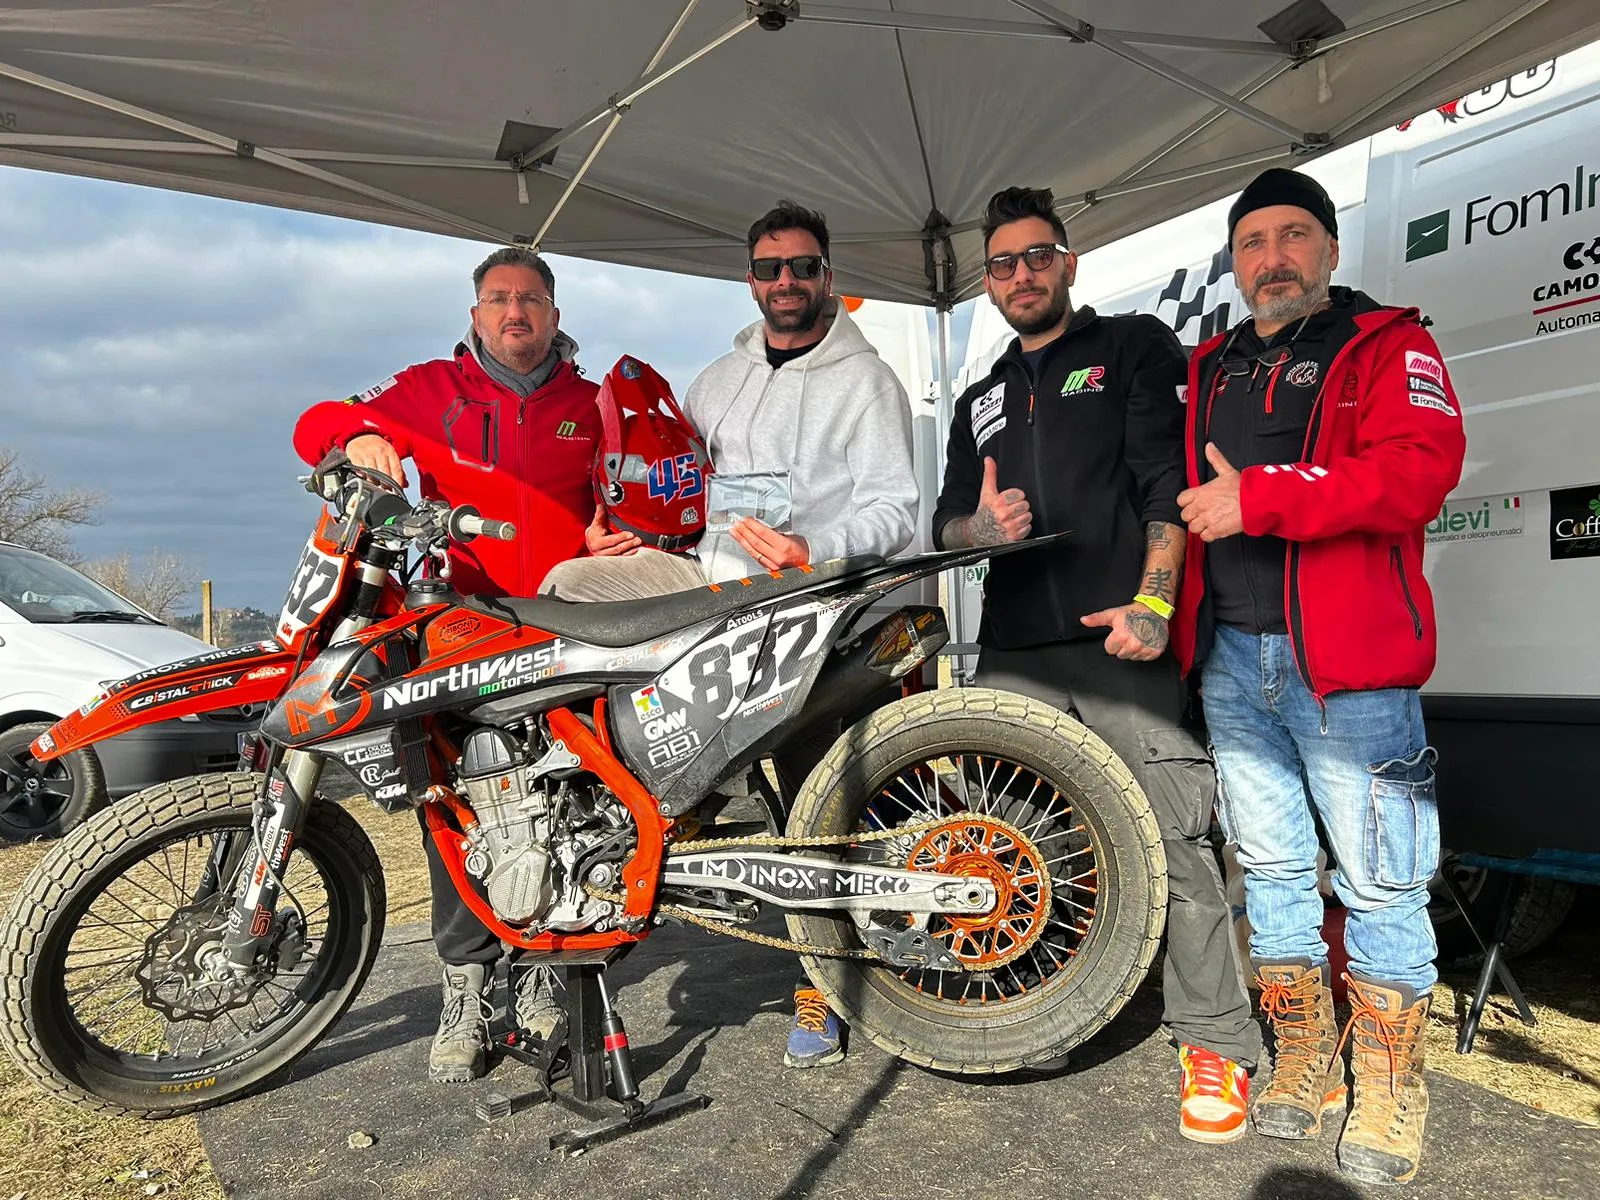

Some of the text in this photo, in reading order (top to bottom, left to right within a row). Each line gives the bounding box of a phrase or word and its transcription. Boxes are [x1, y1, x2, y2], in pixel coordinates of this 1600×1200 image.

[647, 452, 704, 506] 45
[281, 622, 292, 638] KTM
[136, 661, 187, 681] INOX
[383, 638, 566, 710] NorthWest
[479, 661, 566, 697] motorsport
[688, 611, 817, 718] 832
[644, 708, 686, 740] GMV
[648, 731, 700, 766] AB1
[376, 783, 407, 798] KTM
[263, 826, 275, 856] ARIOLI
[752, 865, 815, 890] INOX
[160, 1077, 216, 1094] MAXXIS
